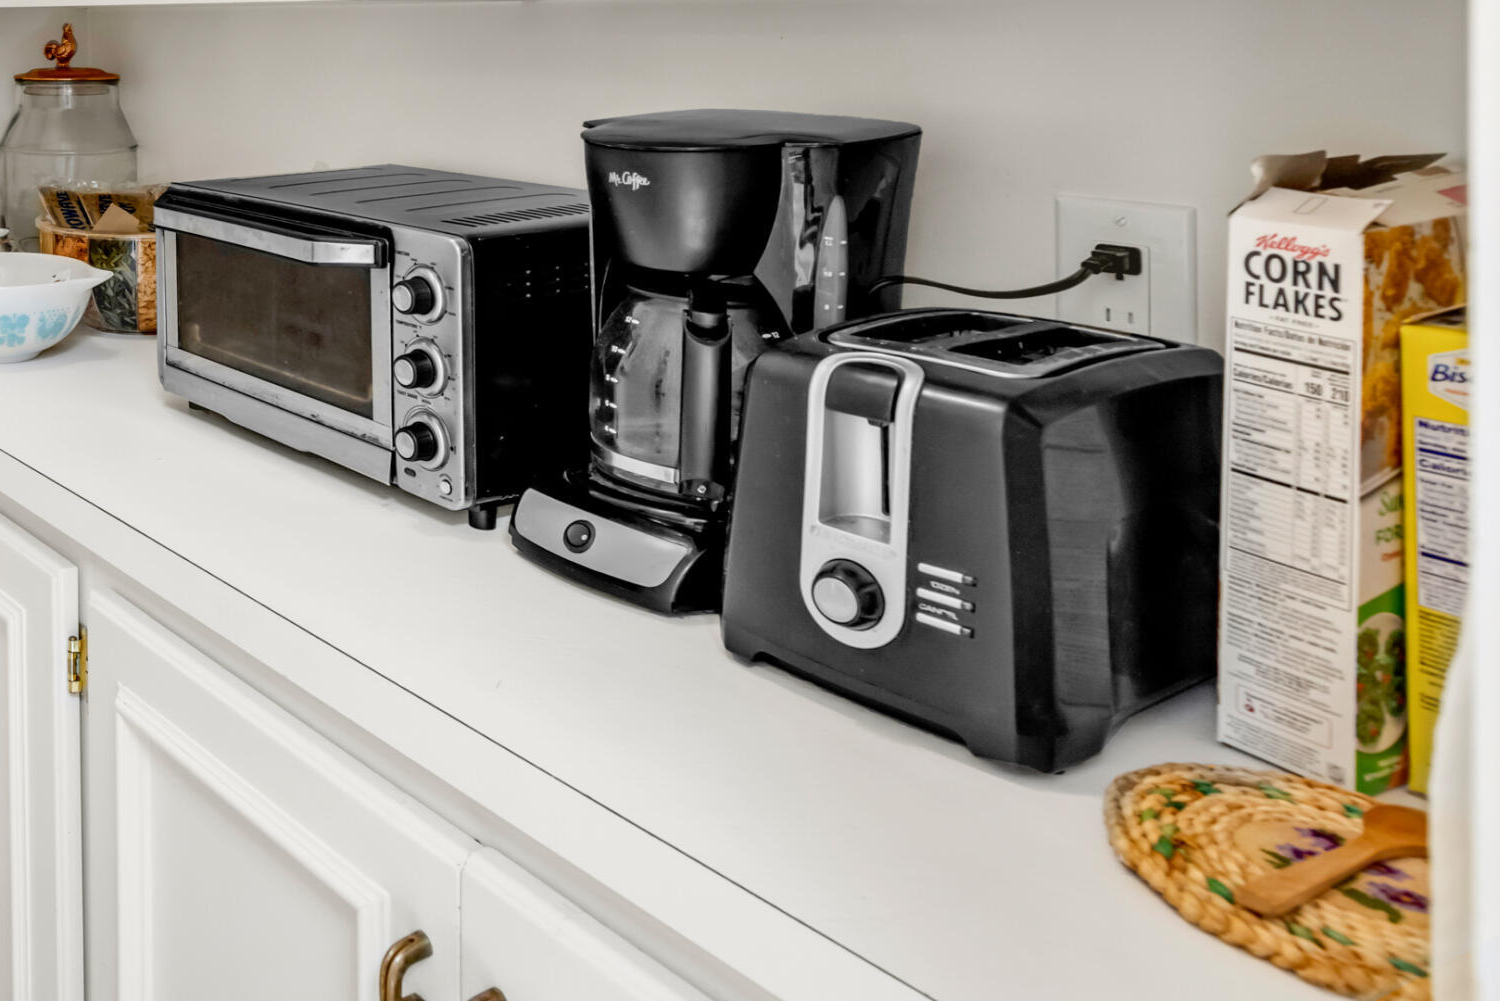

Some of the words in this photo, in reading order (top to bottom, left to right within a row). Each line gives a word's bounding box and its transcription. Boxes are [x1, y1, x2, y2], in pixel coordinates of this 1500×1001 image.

[608, 171, 622, 187] Mr.
[622, 171, 651, 191] Coffee
[1256, 233, 1331, 262] Kellogg's
[1244, 250, 1342, 294] CORN
[1245, 280, 1343, 321] FLAKES
